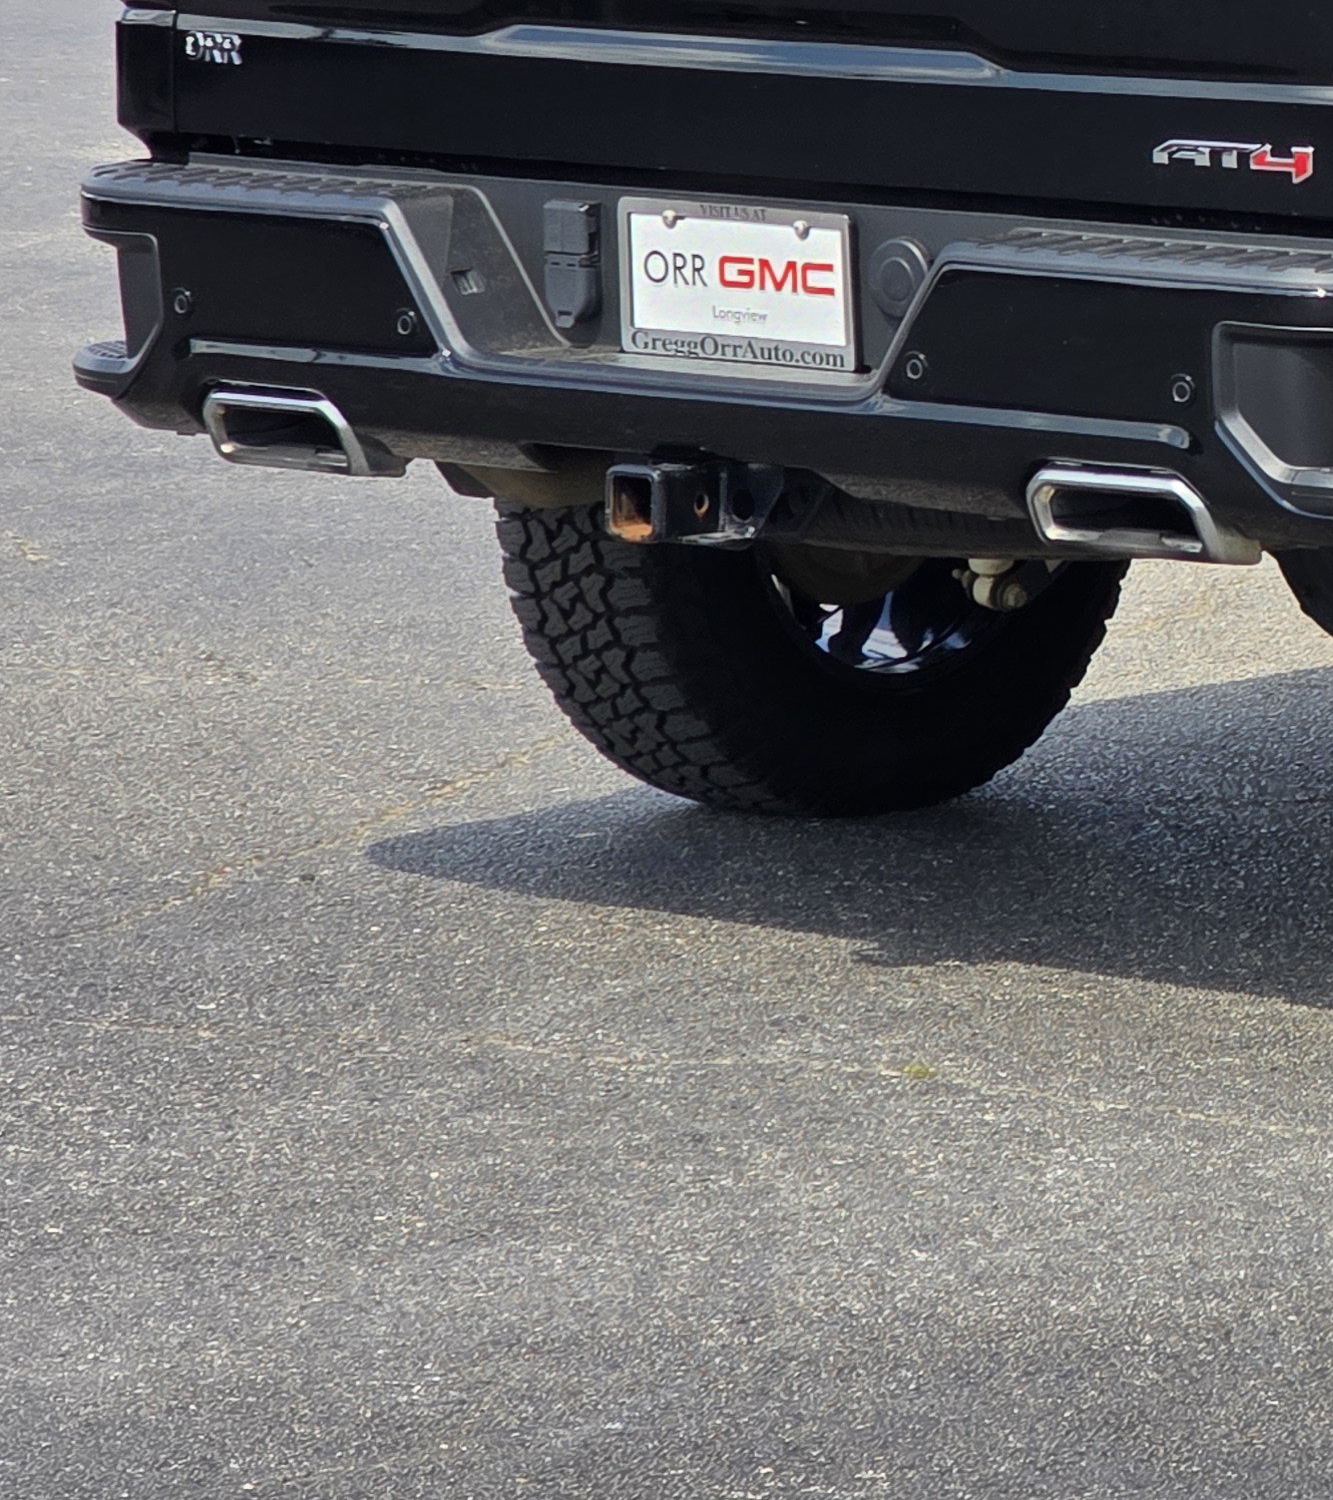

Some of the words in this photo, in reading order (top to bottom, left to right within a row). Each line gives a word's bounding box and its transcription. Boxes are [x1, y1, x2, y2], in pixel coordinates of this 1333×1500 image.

[1152, 138, 1315, 185] AT4
[644, 250, 708, 288] ORR
[718, 255, 836, 297] GMC
[712, 304, 768, 326] Longview
[630, 329, 846, 369] GreggOrrAuto.com
